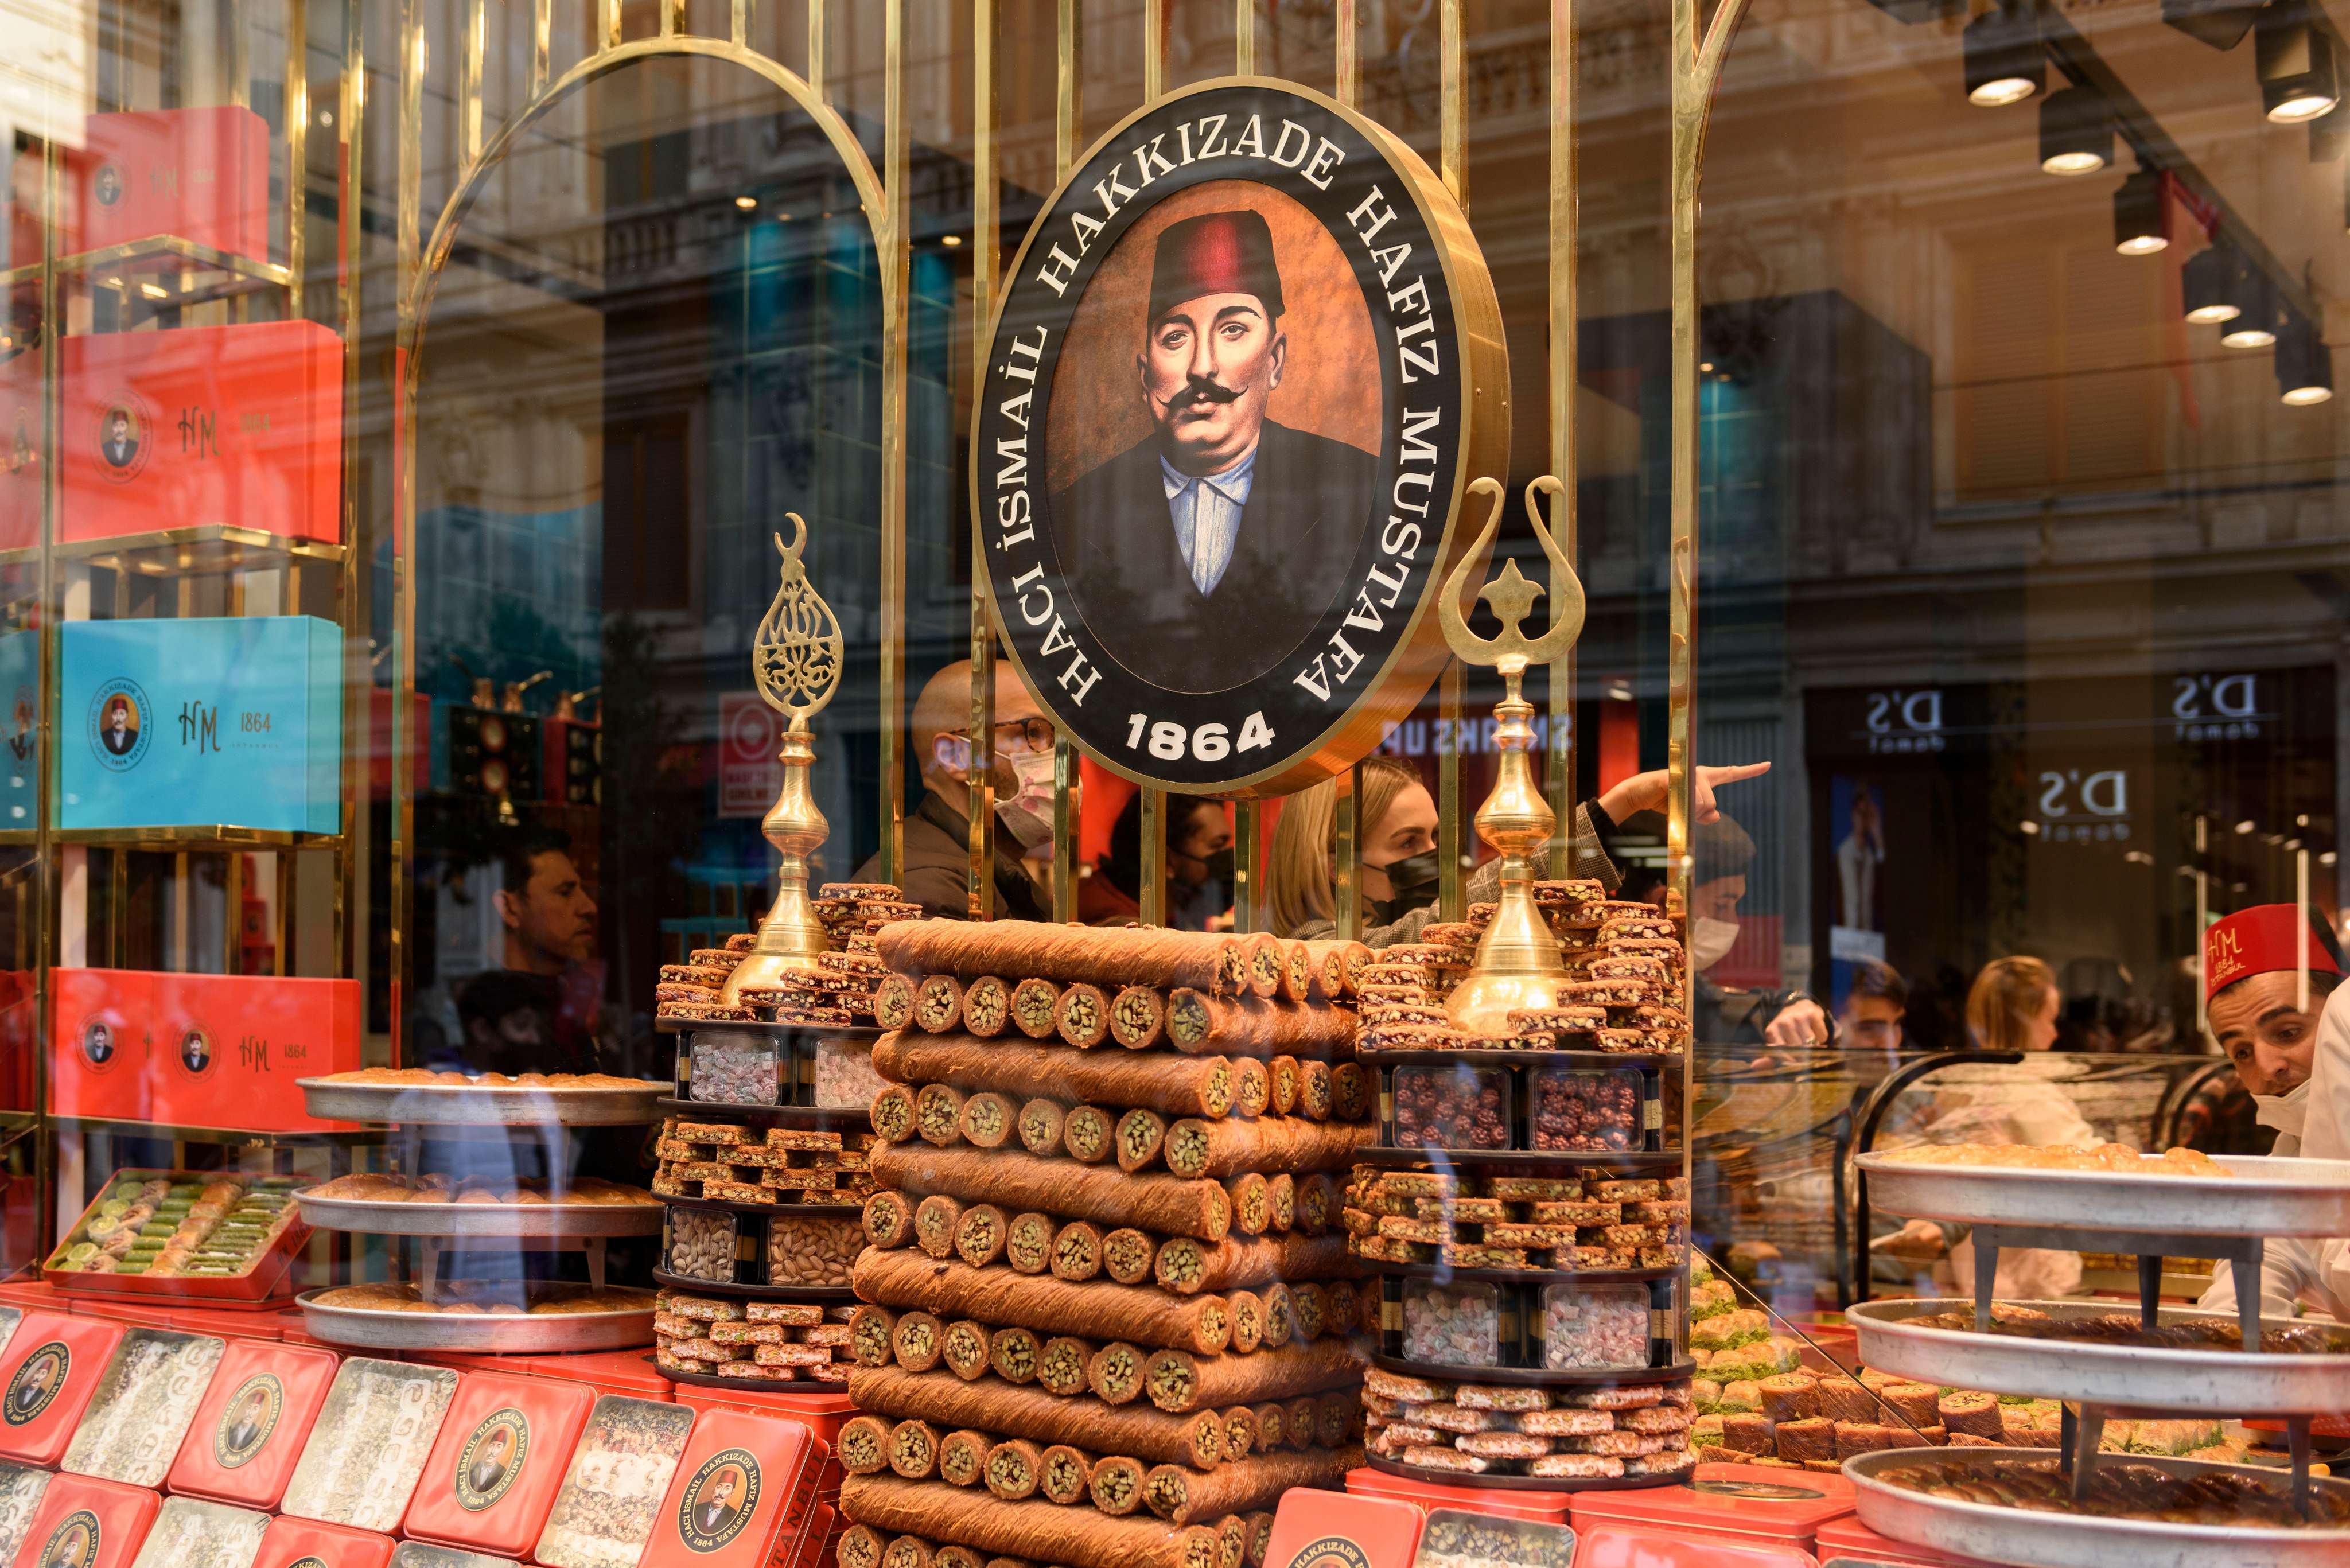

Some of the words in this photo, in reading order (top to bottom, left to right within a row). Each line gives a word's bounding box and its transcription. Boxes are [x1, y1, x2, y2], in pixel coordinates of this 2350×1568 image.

[1037, 114, 1346, 298] HAKKIZADE
[1346, 185, 1441, 384] HAFIZ
[177, 406, 221, 459] HM
[996, 325, 1049, 552] İSMAİL
[1293, 406, 1441, 703] MUSTAFA
[1012, 562, 1103, 708] HACI
[178, 700, 221, 754] HM
[240, 712, 271, 732] 1864
[1126, 710, 1275, 761] 1864
[239, 1035, 271, 1073] HM
[285, 1044, 306, 1058] 1864
[477, 1413, 523, 1436] HAKKIZADE
[516, 1428, 526, 1458] HAFIZ
[487, 1461, 520, 1500] MUSTAFA
[702, 1453, 753, 1476] HAKKIZADE
[459, 1474, 469, 1497] HACI
[467, 1496, 484, 1505] 1864
[682, 1477, 702, 1513] İSMAİL
[748, 1469, 757, 1501] HAFIZ
[683, 1515, 695, 1538] HACI
[716, 1503, 753, 1543] MUSTAFA
[771, 1449, 826, 1567] TANBUL
[692, 1537, 713, 1547] 1864
